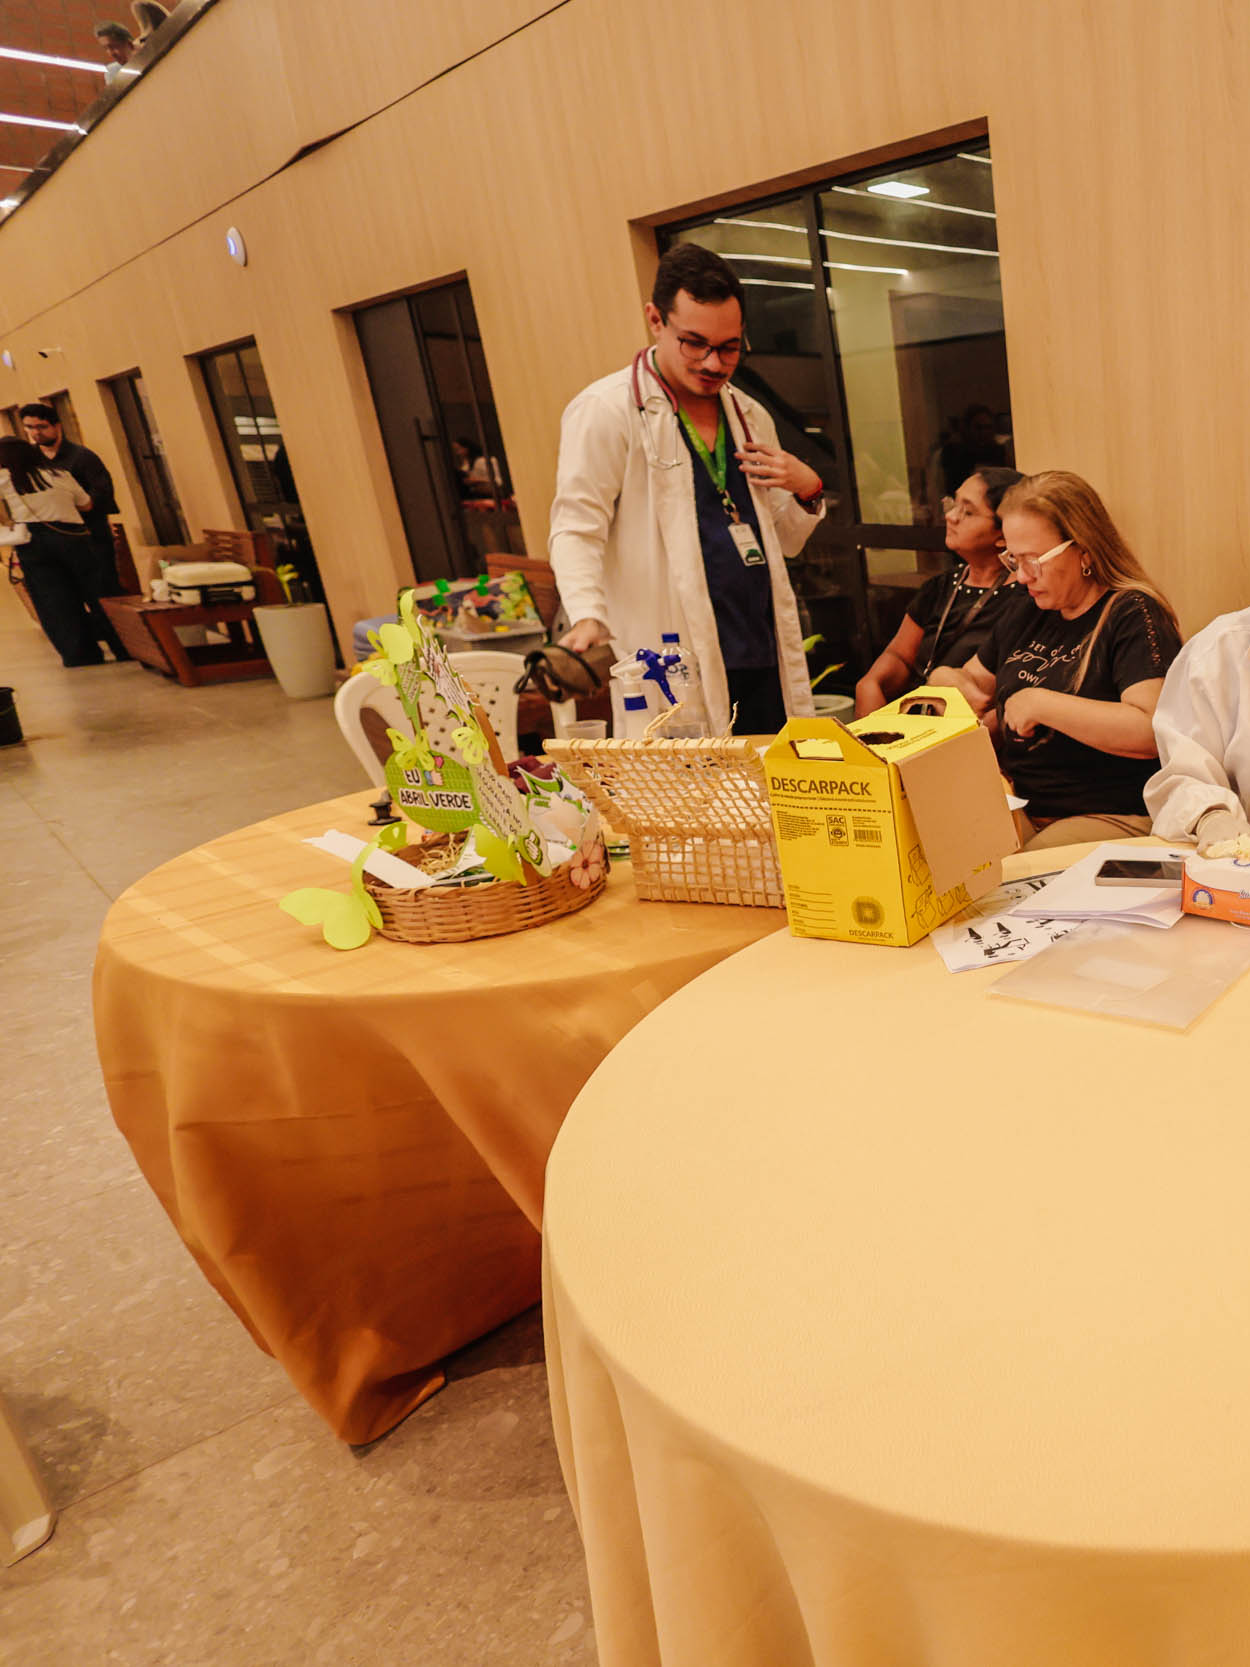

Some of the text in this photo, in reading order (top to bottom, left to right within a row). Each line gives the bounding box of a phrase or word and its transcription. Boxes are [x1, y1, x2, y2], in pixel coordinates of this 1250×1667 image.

[405, 768, 421, 784] EU
[771, 776, 872, 796] DESCARPACK
[400, 790, 471, 809] ABRIL VERDE
[828, 816, 844, 824] SAC
[848, 929, 894, 939] DESCARPACK
